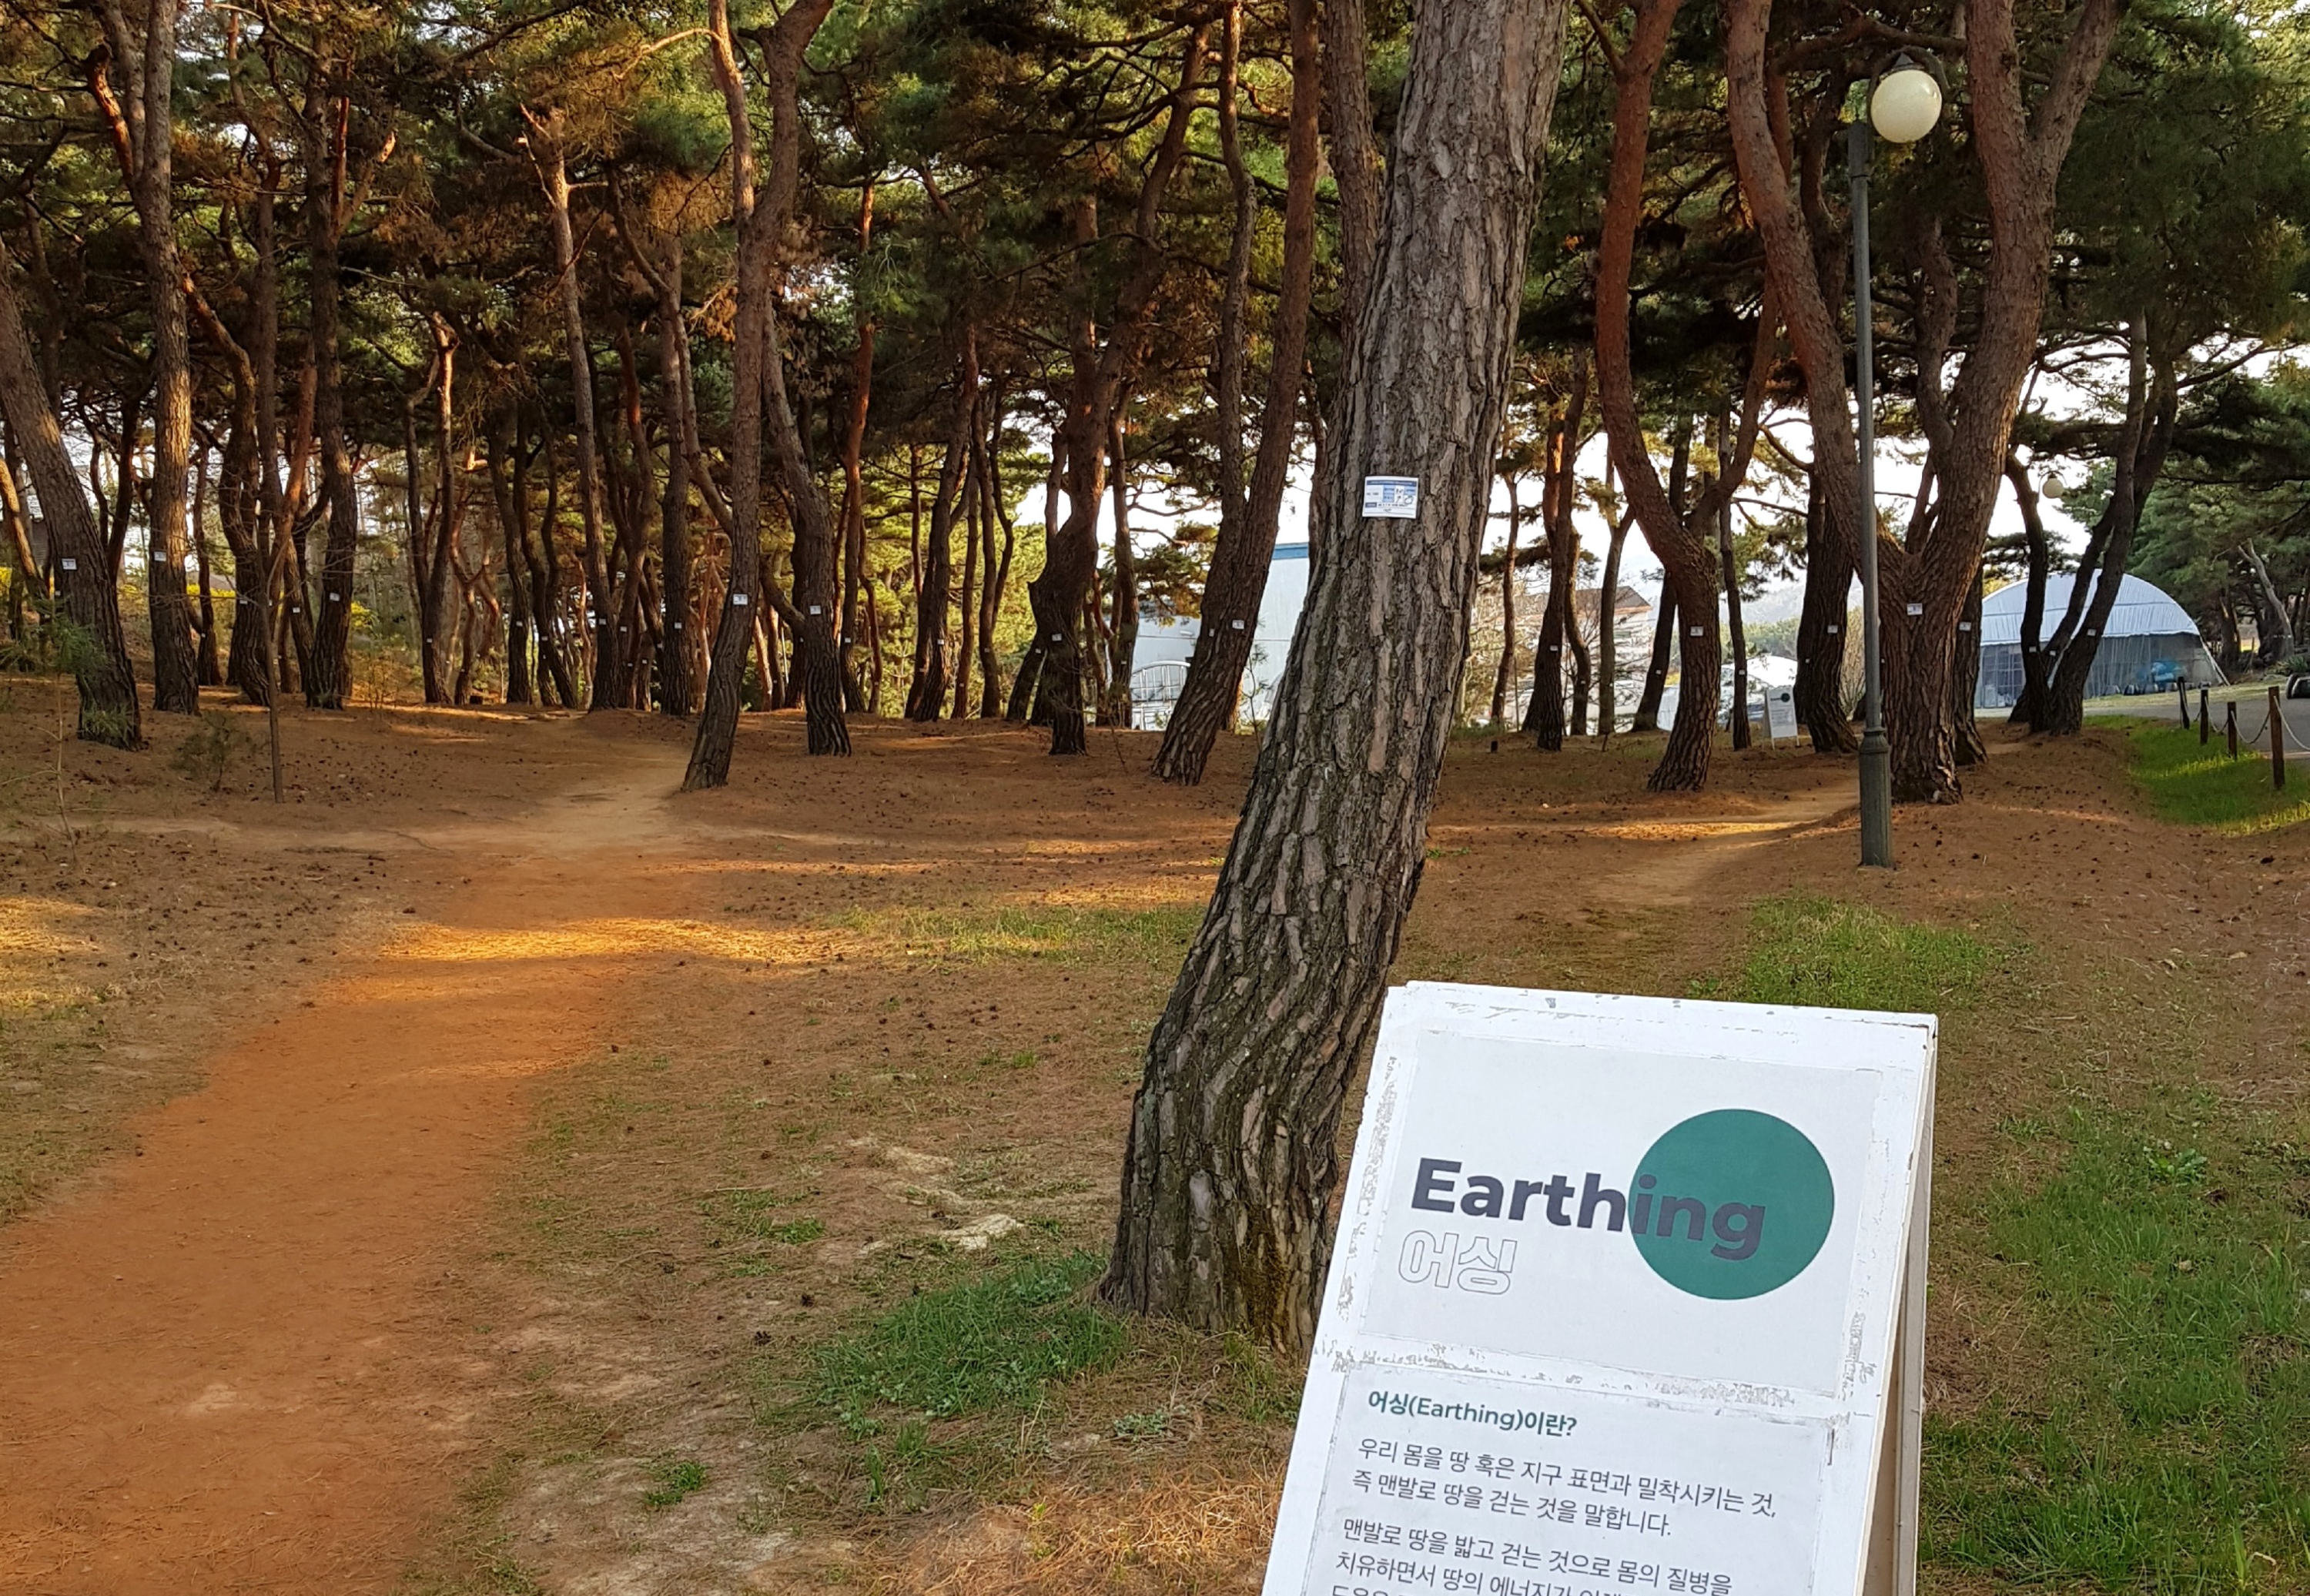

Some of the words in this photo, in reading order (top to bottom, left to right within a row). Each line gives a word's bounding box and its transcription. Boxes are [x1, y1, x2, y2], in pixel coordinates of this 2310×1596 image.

[1411, 1157, 1766, 1260] Earthing
[1398, 1230, 1518, 1295] 어싱
[1368, 1390, 1577, 1437] 어싱(Earthing)이란?
[1352, 1469, 1372, 1493] 즉
[1378, 1474, 1436, 1501] 맨발로
[1444, 1484, 1484, 1509] 땅을
[1489, 1490, 1530, 1516] 걷는
[1536, 1497, 1578, 1524] 것을
[1585, 1504, 1671, 1537] 말합니다.
[1358, 1438, 1398, 1463] 우리
[1403, 1444, 1443, 1470] 몸을
[1450, 1450, 1470, 1473] 땅
[1475, 1454, 1515, 1480] 혹은
[1521, 1460, 1562, 1486] 지구
[1567, 1467, 1632, 1496] 표면과
[1639, 1477, 1744, 1513] 밀착시키는
[1751, 1492, 1776, 1517] 것,
[1336, 1551, 1436, 1588] 치유하면서
[1443, 1568, 1483, 1594] 땅의
[1344, 1518, 1401, 1545] 맨발로
[1408, 1529, 1448, 1554] 땅을
[1455, 1535, 1494, 1560] 밟고
[1502, 1542, 1542, 1569] 걷는
[1548, 1551, 1610, 1578] 것으로
[1617, 1560, 1659, 1588] 몸의
[1667, 1568, 1732, 1596] 질병을
